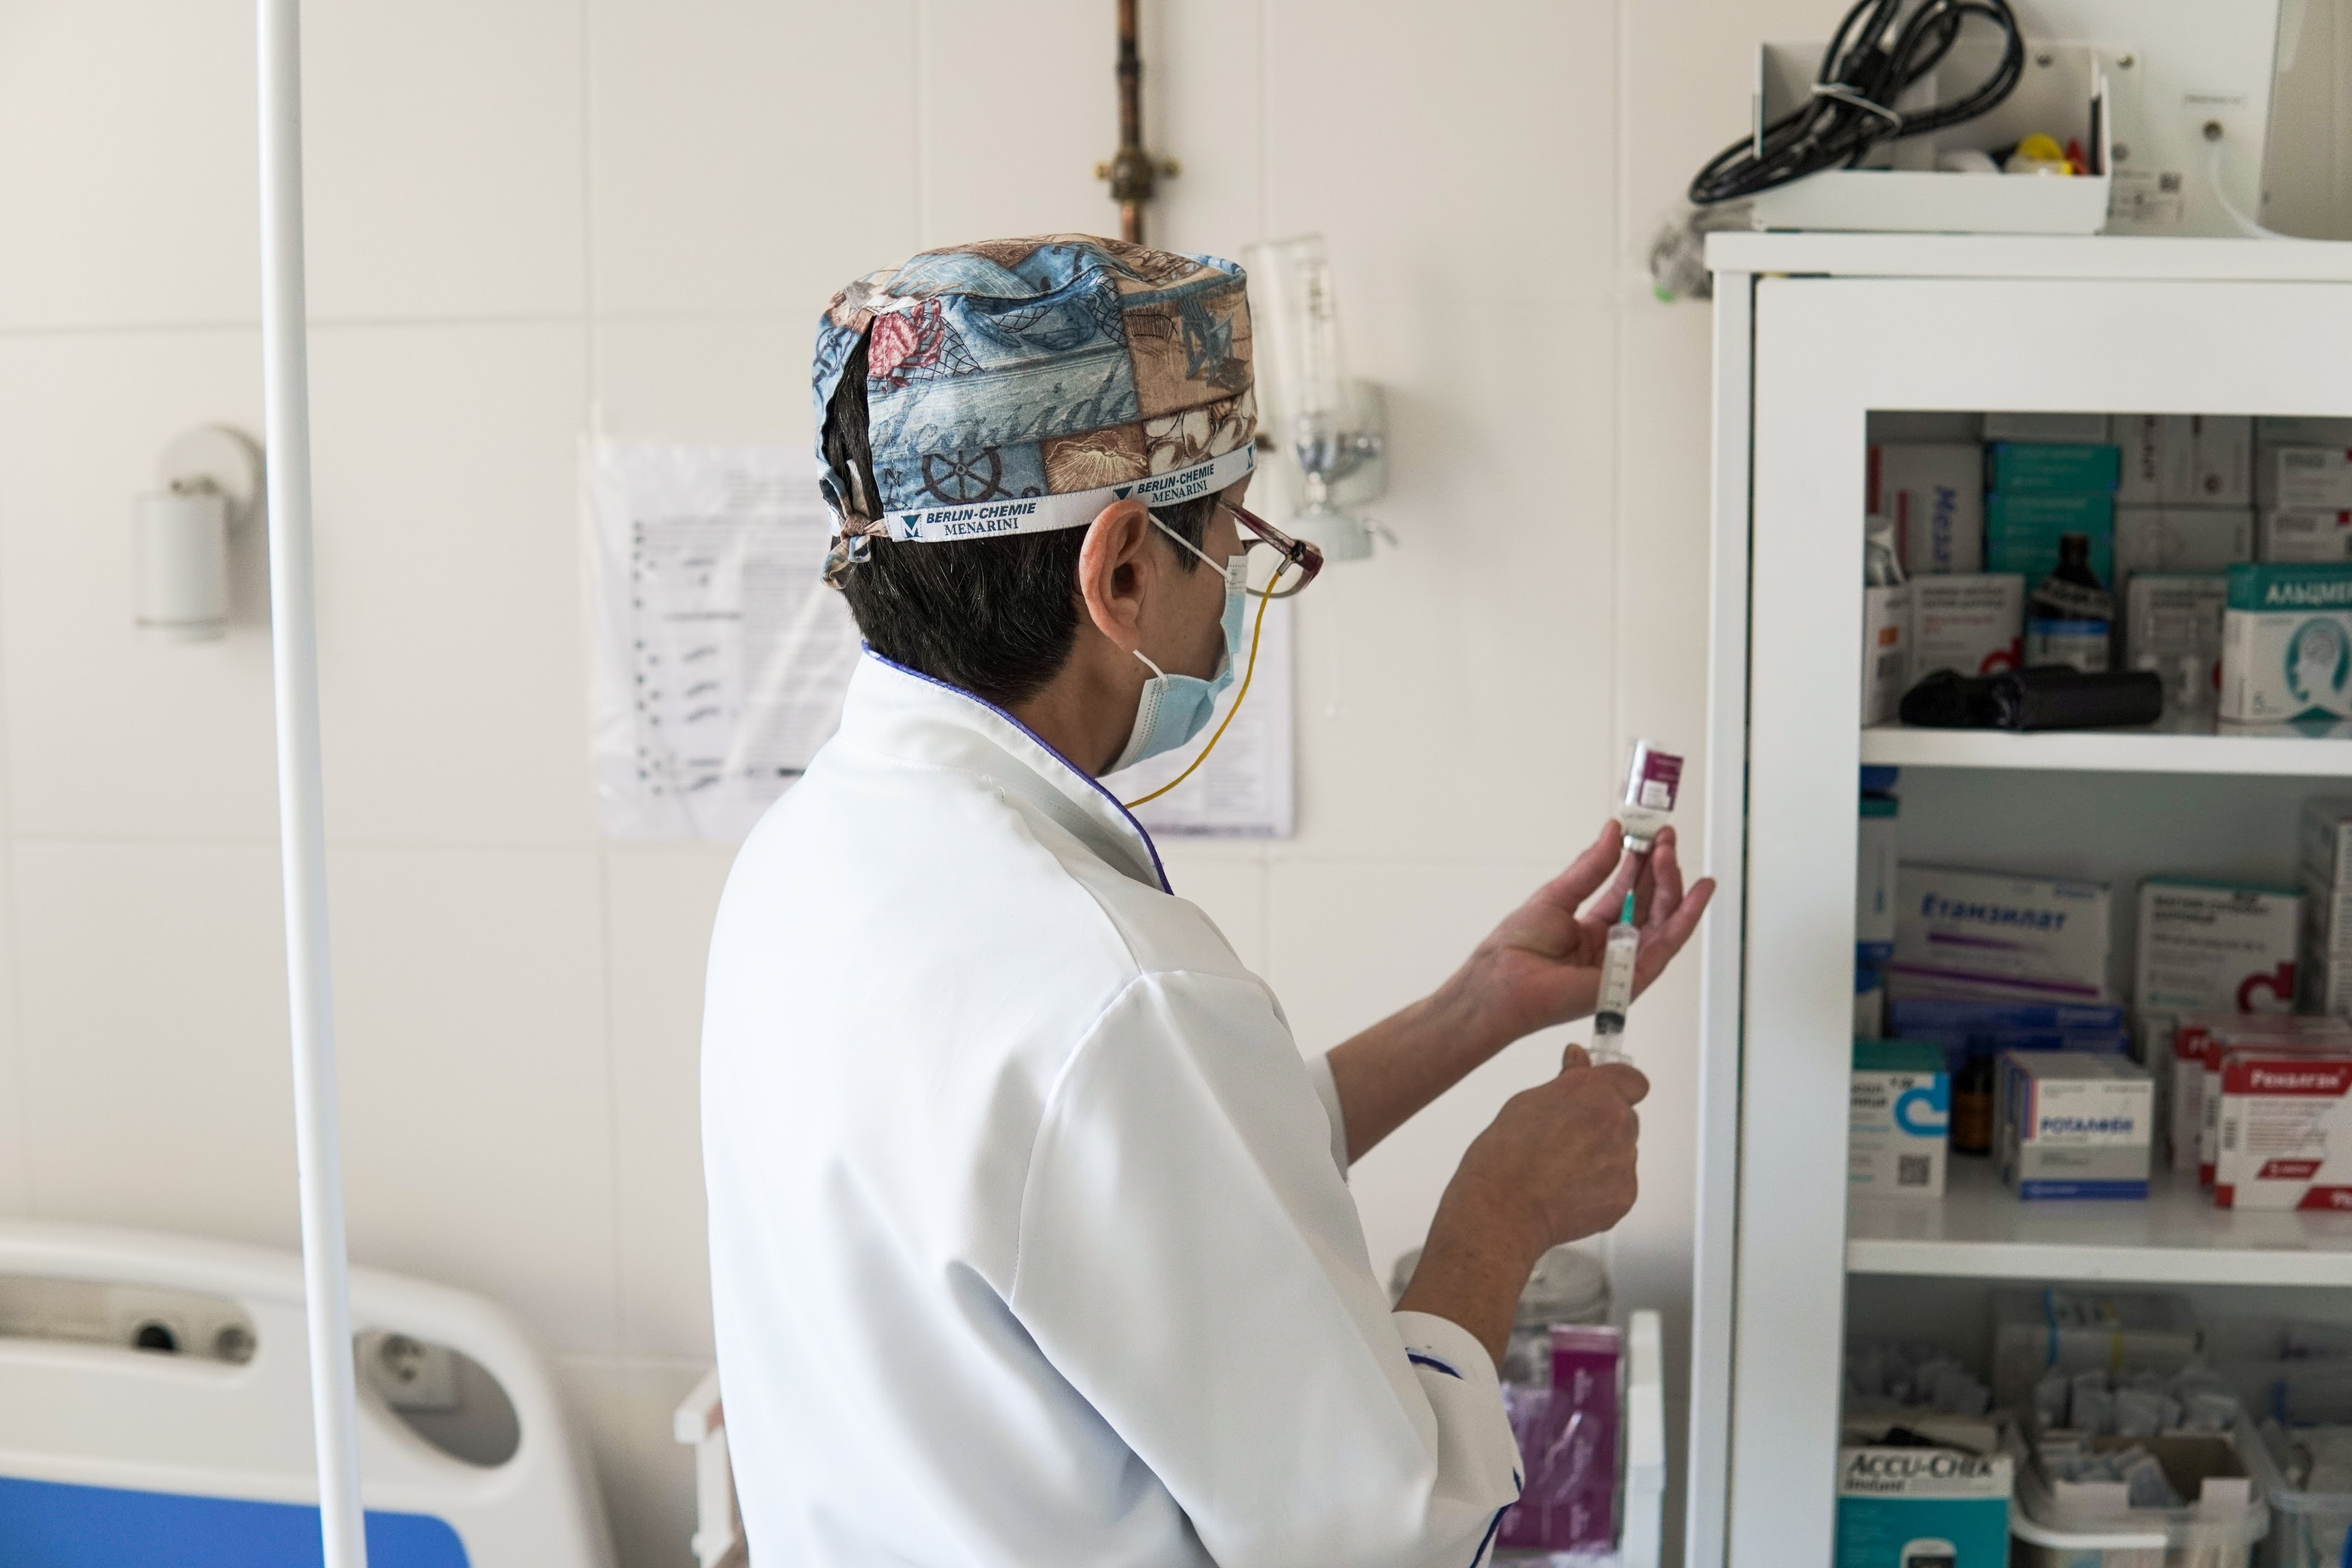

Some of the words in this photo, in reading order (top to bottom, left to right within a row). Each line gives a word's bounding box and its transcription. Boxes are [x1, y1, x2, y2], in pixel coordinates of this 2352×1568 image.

[1138, 464, 1214, 494] BERLIN-CHEMIE
[1152, 480, 1208, 503] MENARINI
[927, 502, 1037, 523] BERLIN-CHEMIE
[944, 518, 1018, 536] MENARINI
